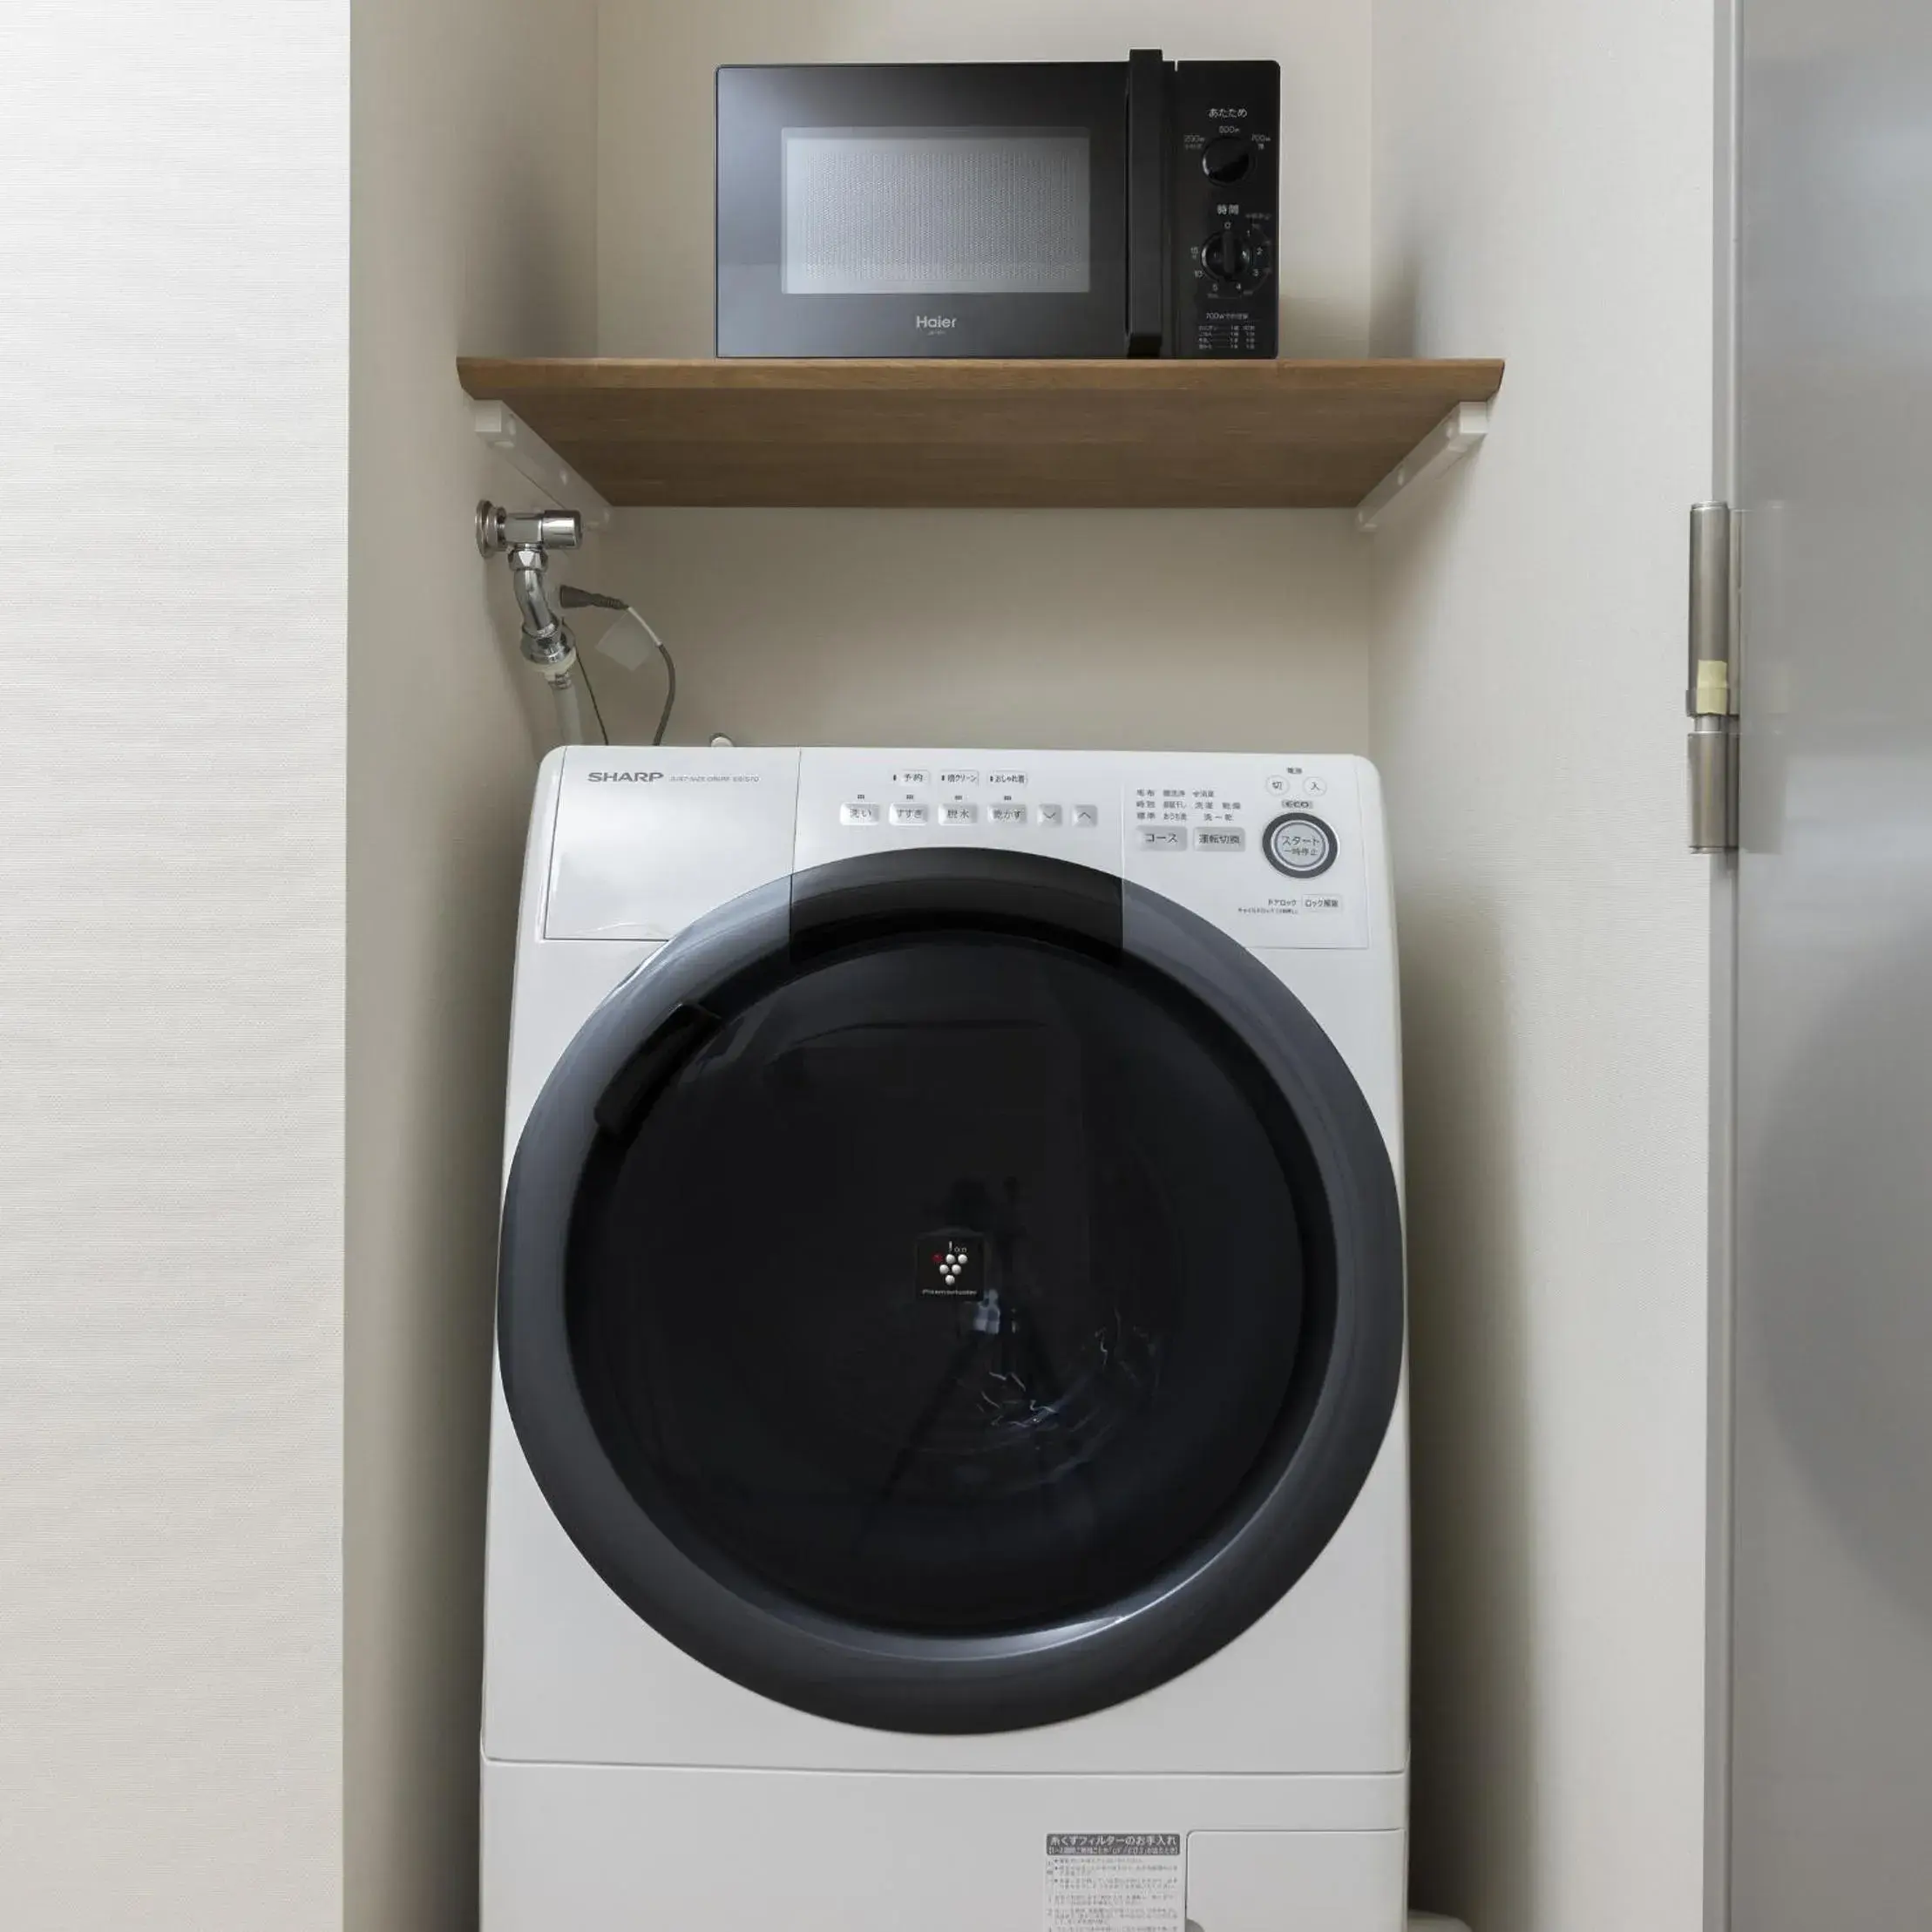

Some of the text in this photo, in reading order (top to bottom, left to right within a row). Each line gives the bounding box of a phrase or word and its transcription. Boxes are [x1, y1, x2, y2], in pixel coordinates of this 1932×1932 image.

[1209, 108, 1247, 118] あたため
[917, 315, 957, 328] Haier
[587, 772, 664, 783] SHARP
[904, 773, 924, 783] 予約
[1272, 781, 1283, 790] 切
[1310, 782, 1320, 790] 入
[947, 809, 969, 819] 脱水
[1145, 833, 1179, 844] コース
[1282, 836, 1320, 846] スタート
